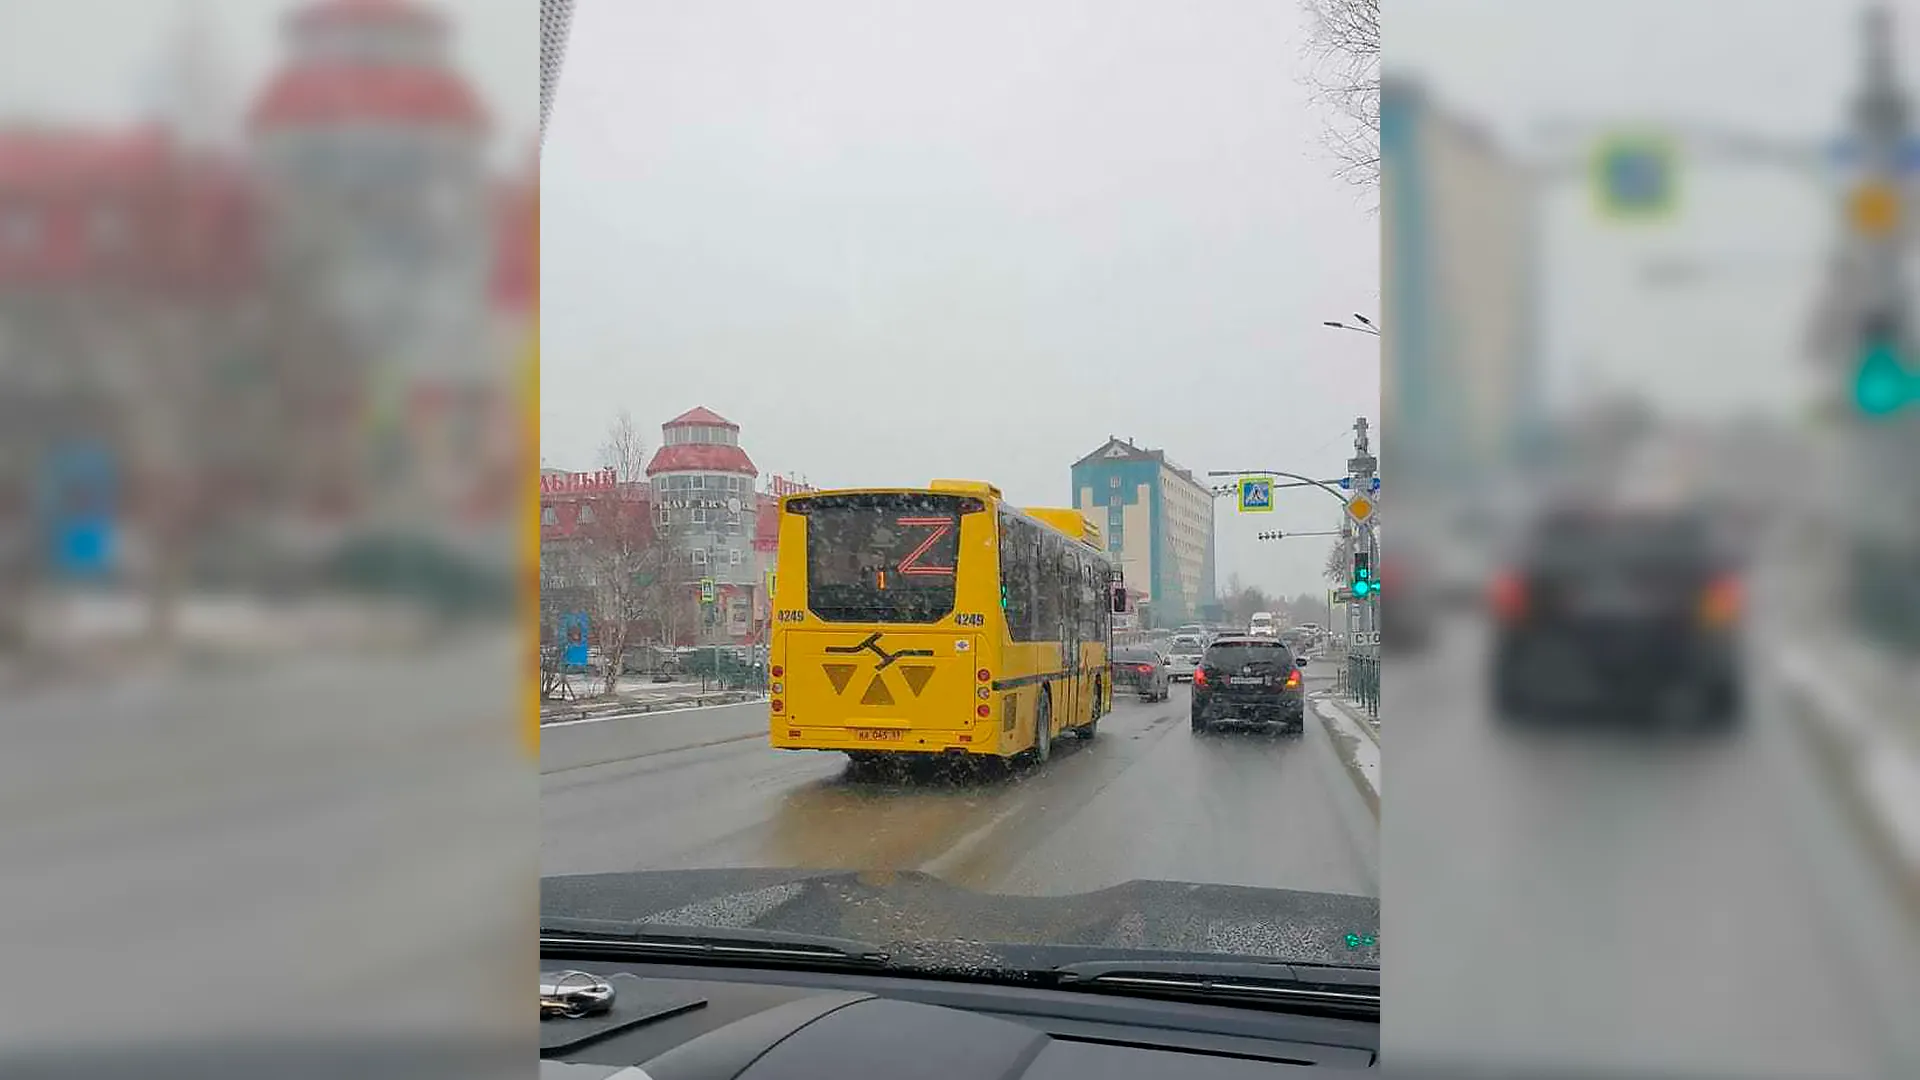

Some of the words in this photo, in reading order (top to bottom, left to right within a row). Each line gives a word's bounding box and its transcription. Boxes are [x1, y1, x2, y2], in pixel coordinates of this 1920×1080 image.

[896, 516, 953, 575] Z
[777, 609, 804, 622] 4249
[954, 613, 984, 627] 4249
